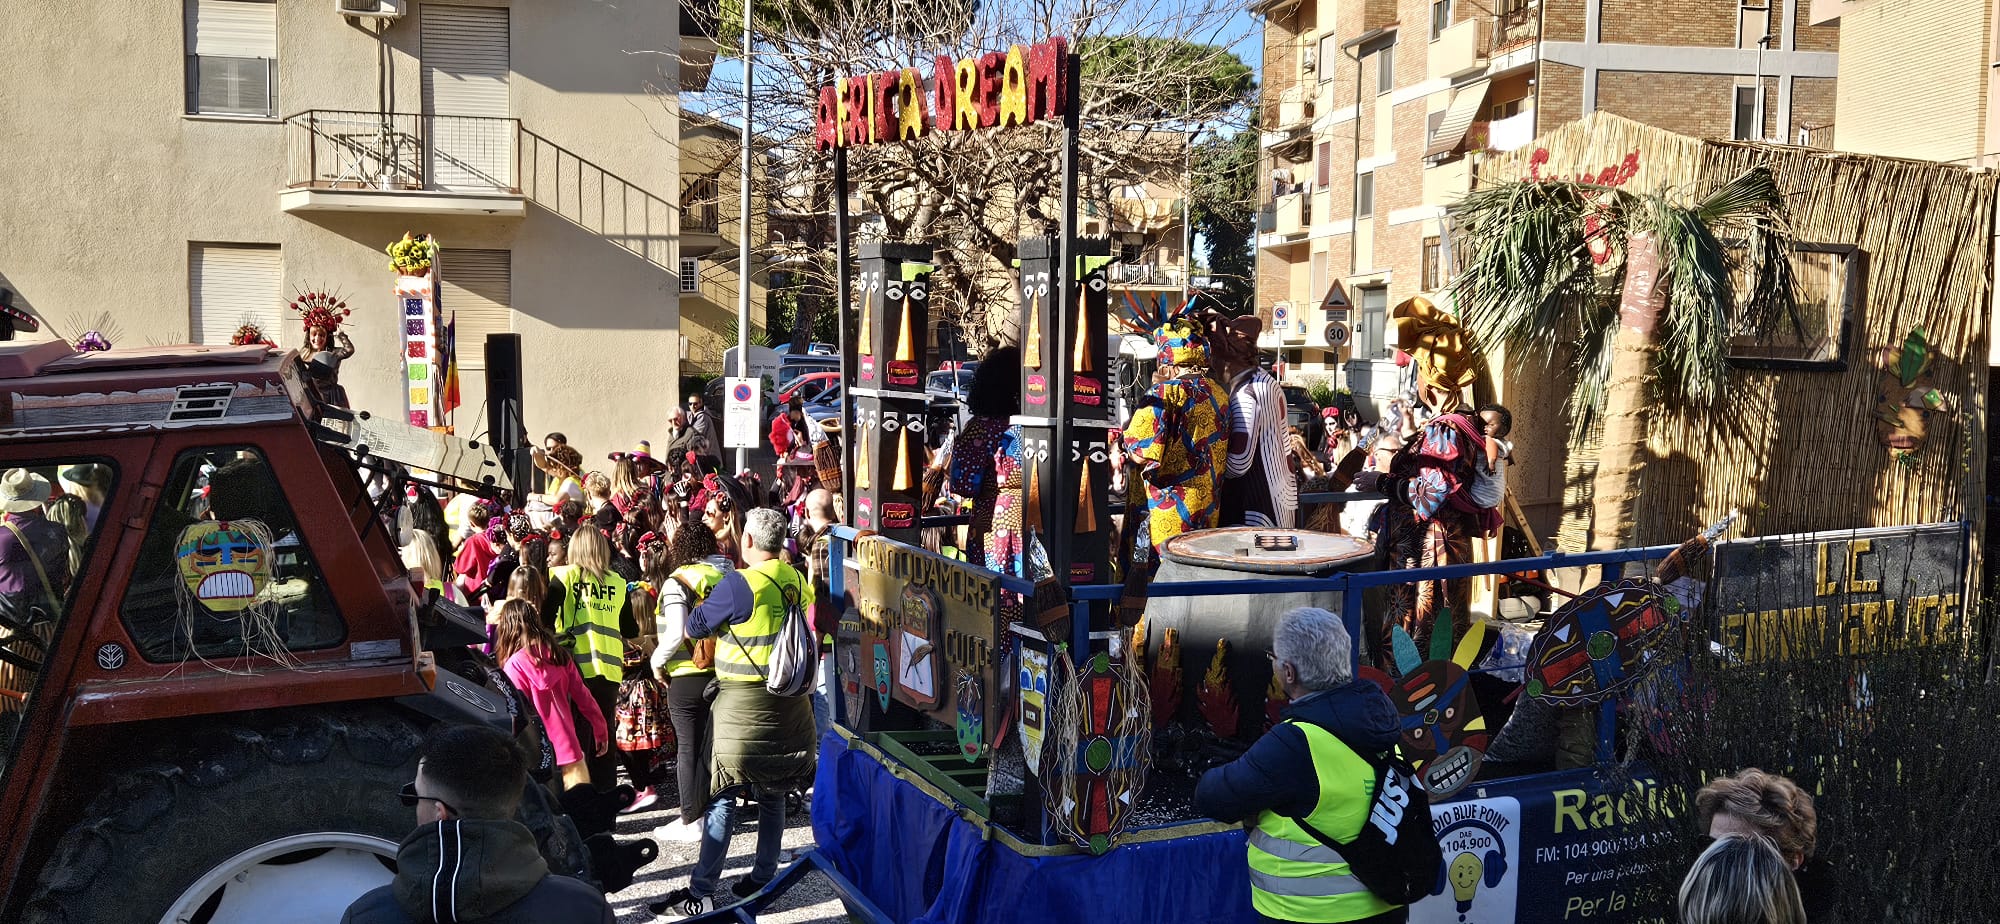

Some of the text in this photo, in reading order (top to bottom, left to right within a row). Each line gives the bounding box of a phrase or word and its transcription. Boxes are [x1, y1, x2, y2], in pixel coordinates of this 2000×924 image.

[816, 36, 1067, 151] AFRICA DREAM
[1329, 328, 1344, 340] 30
[573, 582, 615, 601] STAFF
[1432, 804, 1510, 834] DIO BLUE POINT
[1447, 837, 1491, 853] 104.900
[1536, 847, 1560, 863] FM:
[1565, 871, 1589, 885] Per
[1564, 896, 1603, 921] Per
[1607, 890, 1626, 912] la
